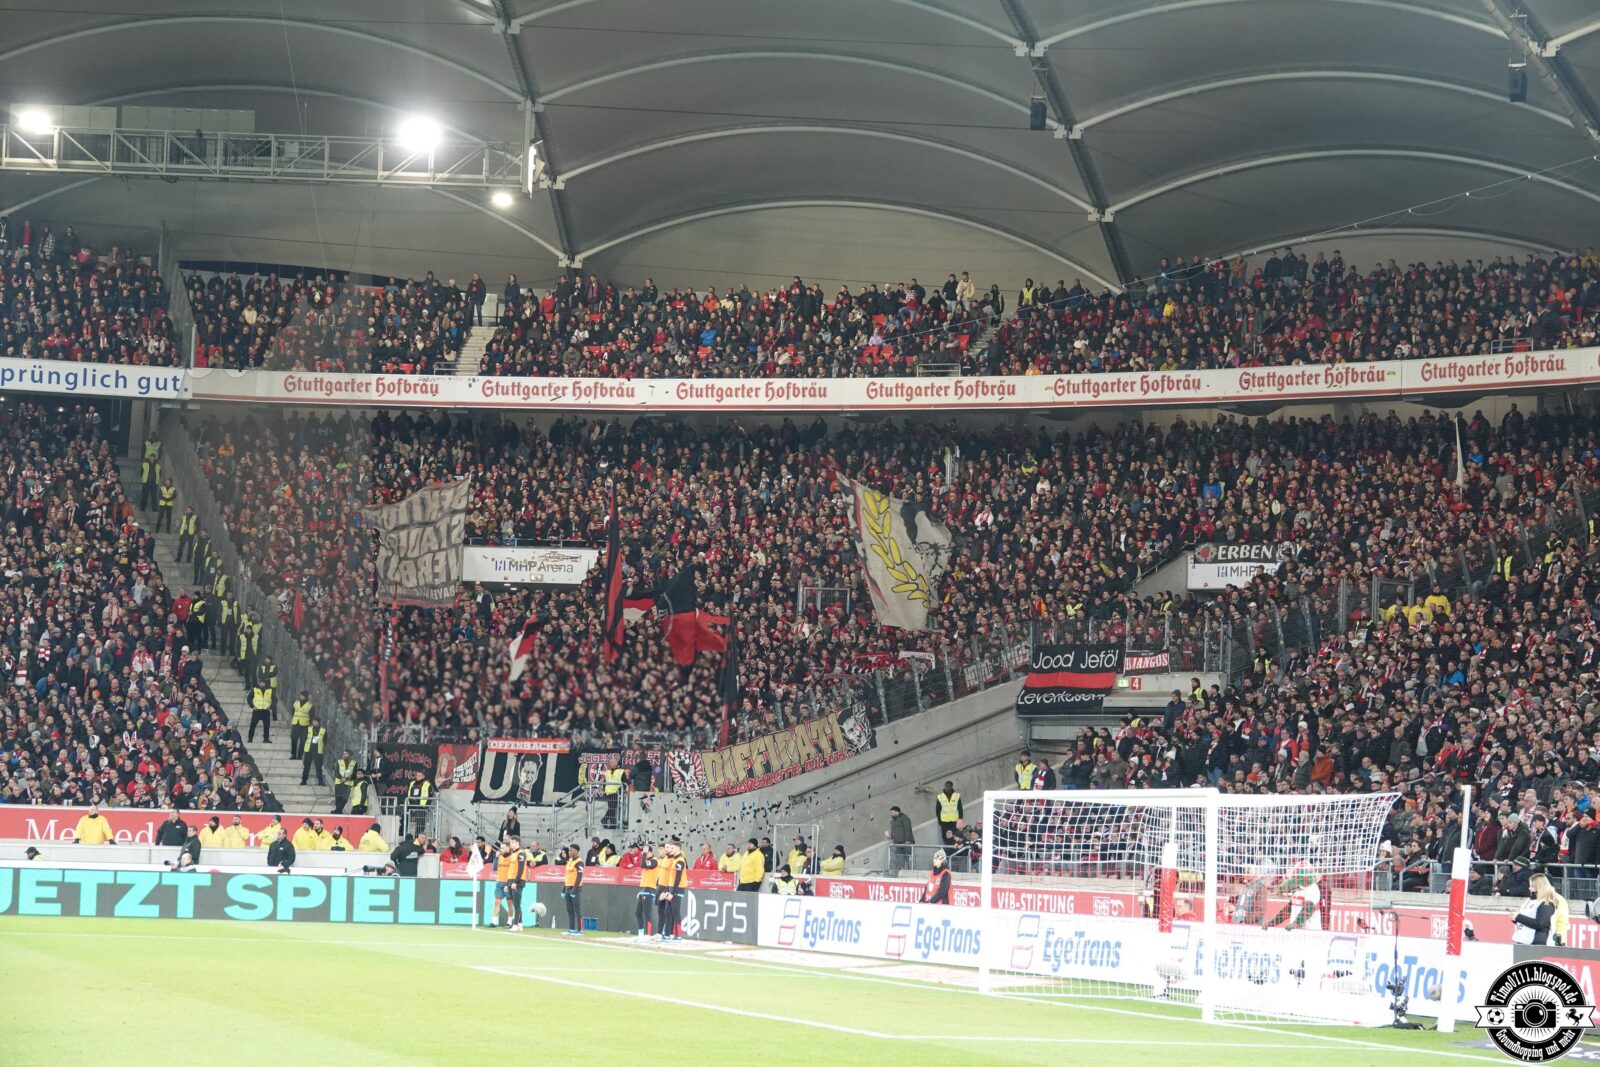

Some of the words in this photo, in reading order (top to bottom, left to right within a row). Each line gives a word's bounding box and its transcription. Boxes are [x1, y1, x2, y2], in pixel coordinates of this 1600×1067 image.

[1239, 368, 1322, 391] Stuttgarter
[1324, 364, 1385, 388] Hofbräu
[1421, 360, 1502, 382] Stuttgarter
[1505, 353, 1567, 378] Hofbräu
[137, 373, 188, 395] gut.
[284, 375, 372, 396] Stuttgarter
[482, 379, 570, 400] Stuttgarter
[573, 380, 635, 401] Hofbräu
[676, 381, 761, 402] Stuttgarter
[765, 381, 828, 401] Hofbräu
[866, 380, 950, 401] Stuttgarter
[954, 378, 1016, 400] Hofbräu
[1053, 376, 1136, 398] Stuttgarter
[1140, 373, 1201, 396] Hofbräu
[1217, 544, 1273, 560] ERBEN
[1032, 651, 1075, 669] Jood
[1132, 677, 1140, 689] 4
[997, 891, 1075, 915] VfB-STIFTUNG
[703, 899, 748, 934] PS5
[803, 908, 861, 948] EgeTrans
[915, 917, 980, 960] EgeTrans
[1043, 927, 1122, 973] EgeTrans
